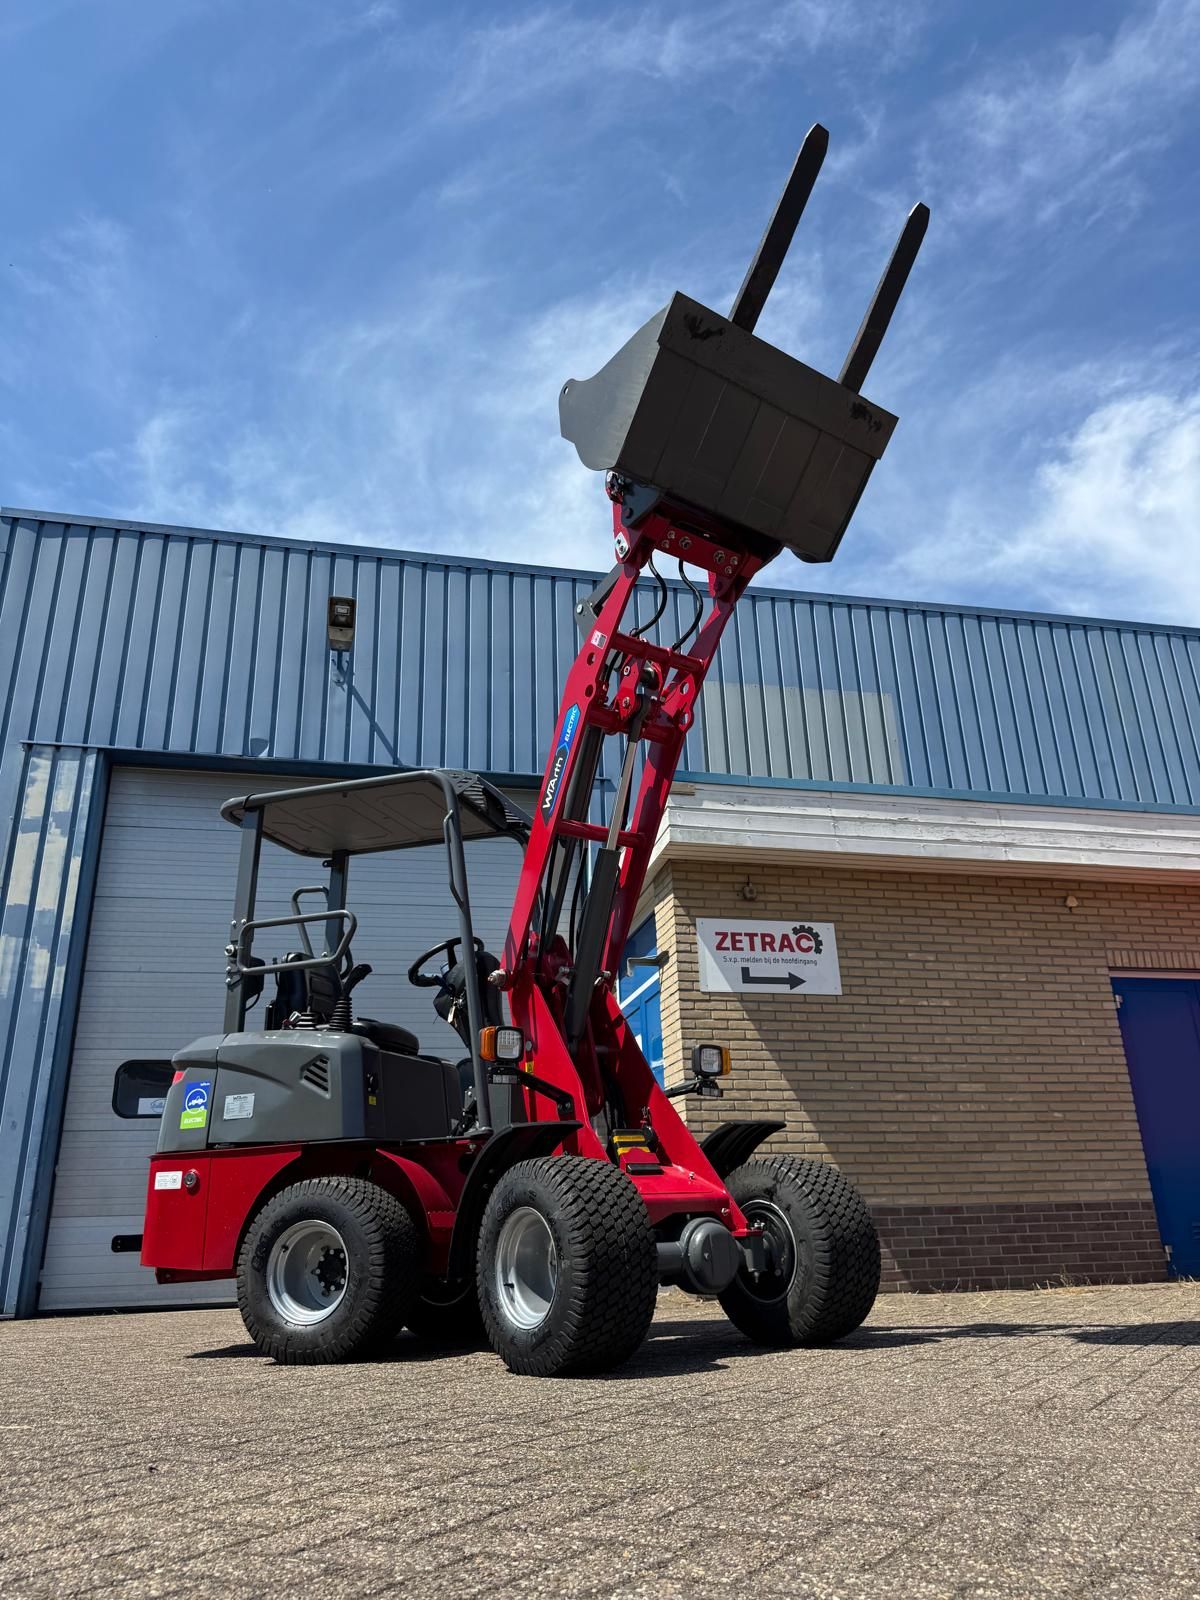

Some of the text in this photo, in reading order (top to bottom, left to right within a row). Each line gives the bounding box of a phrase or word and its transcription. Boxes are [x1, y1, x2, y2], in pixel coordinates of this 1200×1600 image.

[564, 707, 577, 742] ELECTRIC
[715, 931, 814, 953] ZETRAC
[723, 956, 740, 964] S.v.p.
[781, 957, 818, 966] hoofdingang
